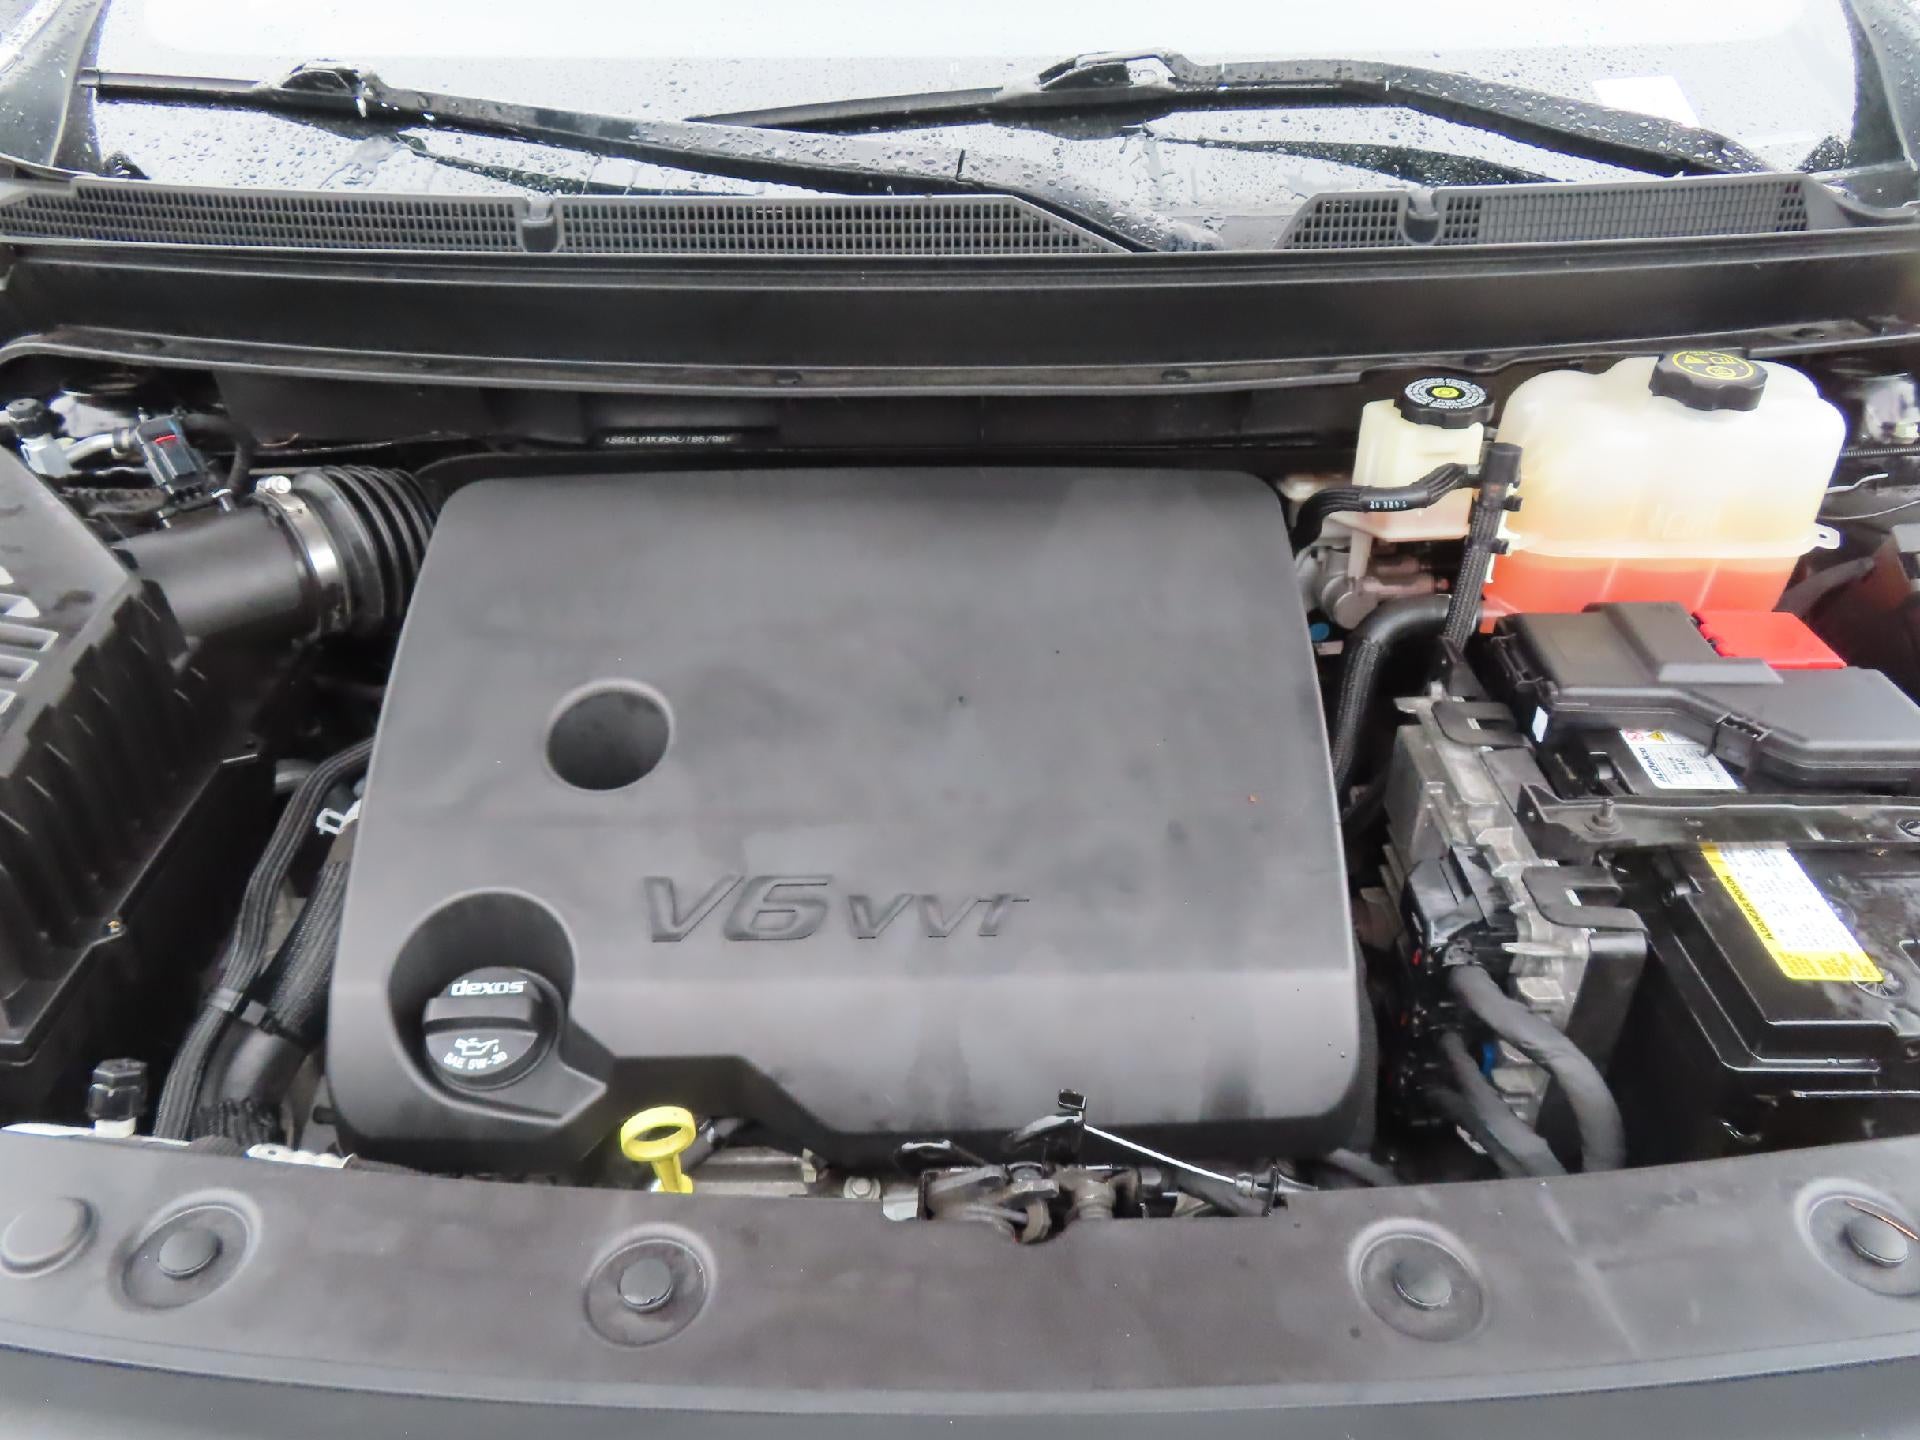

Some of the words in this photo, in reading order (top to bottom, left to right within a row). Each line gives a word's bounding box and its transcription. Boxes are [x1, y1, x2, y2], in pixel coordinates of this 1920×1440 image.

[643, 874, 834, 943] V6
[848, 892, 1031, 940] VVT
[450, 979, 527, 997] dexos
